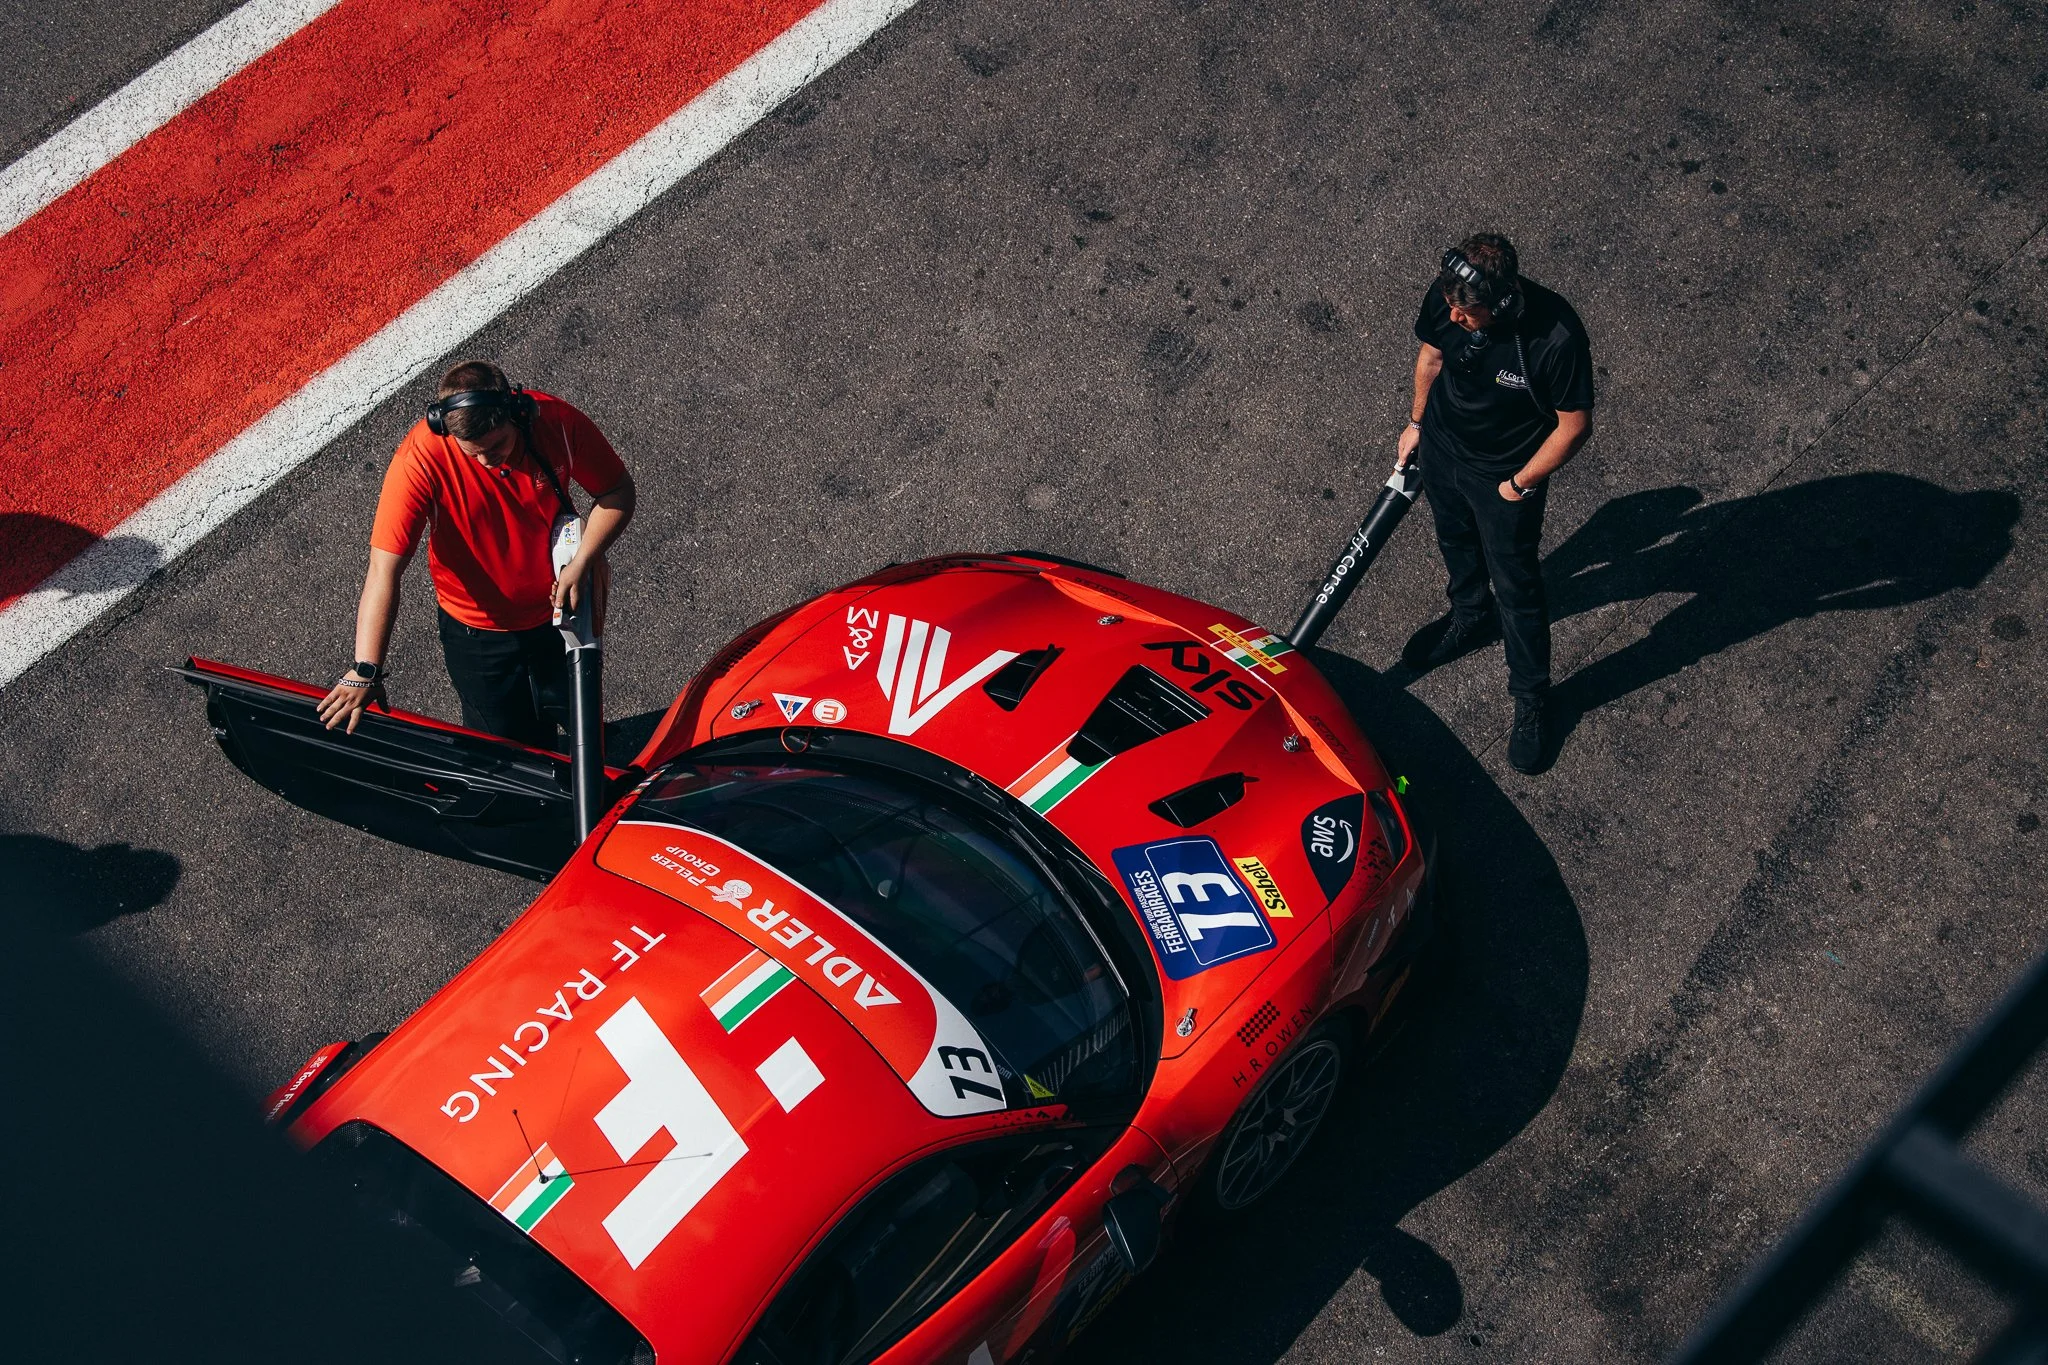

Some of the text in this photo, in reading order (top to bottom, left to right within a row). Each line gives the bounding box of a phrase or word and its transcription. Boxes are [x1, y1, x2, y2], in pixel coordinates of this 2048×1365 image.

[821, 704, 839, 721] E
[1311, 815, 1337, 858] aws
[651, 852, 707, 886] PELZER
[665, 845, 721, 877] GROUP
[1161, 871, 1261, 941] 73
[1242, 861, 1287, 911] Sabelt
[747, 900, 902, 1010] ADLER
[440, 925, 667, 1124] TF RACING
[289, 1069, 316, 1091] Tom
[937, 1046, 1003, 1103] 73
